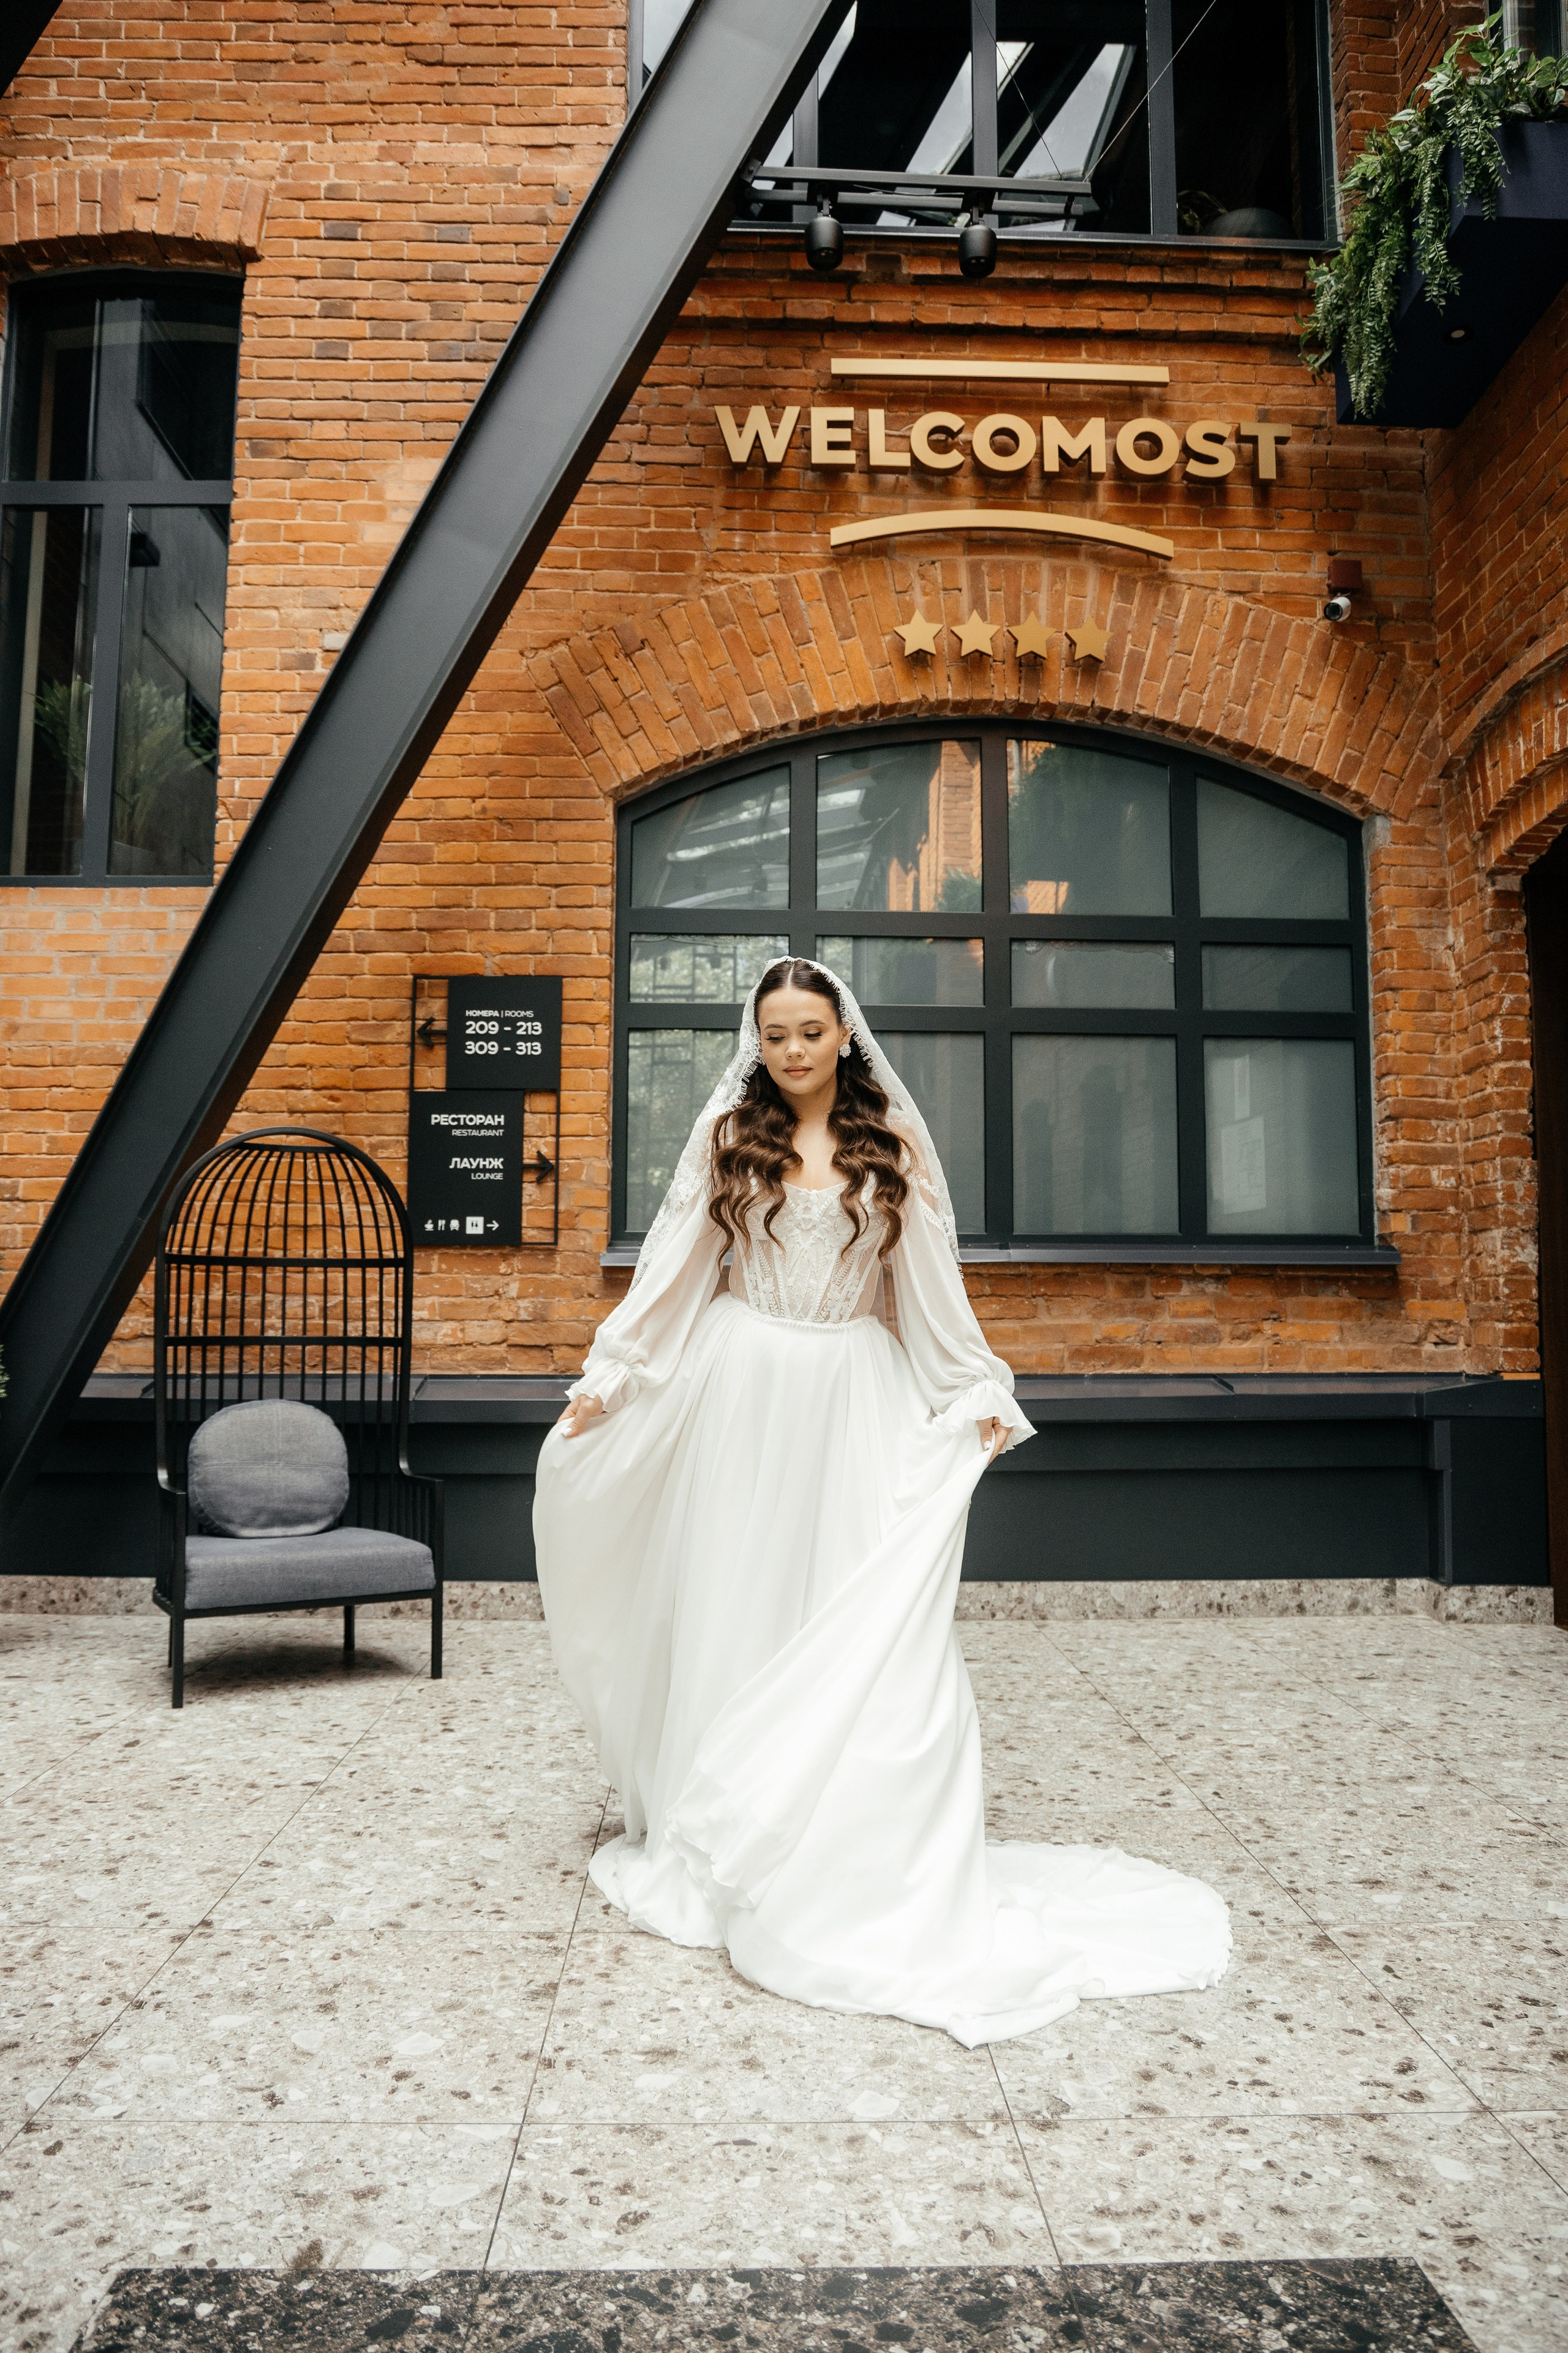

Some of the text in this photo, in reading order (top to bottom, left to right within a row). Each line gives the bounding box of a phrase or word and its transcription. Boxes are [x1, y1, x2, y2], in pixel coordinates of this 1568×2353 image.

[714, 404, 1292, 480] WELCOMOST
[465, 1021, 499, 1035] 209
[516, 1021, 543, 1035] 213
[464, 1041, 499, 1055] 309
[515, 1041, 543, 1056] 313
[431, 1114, 505, 1126] РЕСТОРАН
[449, 1157, 504, 1169] ЛАУНЖ
